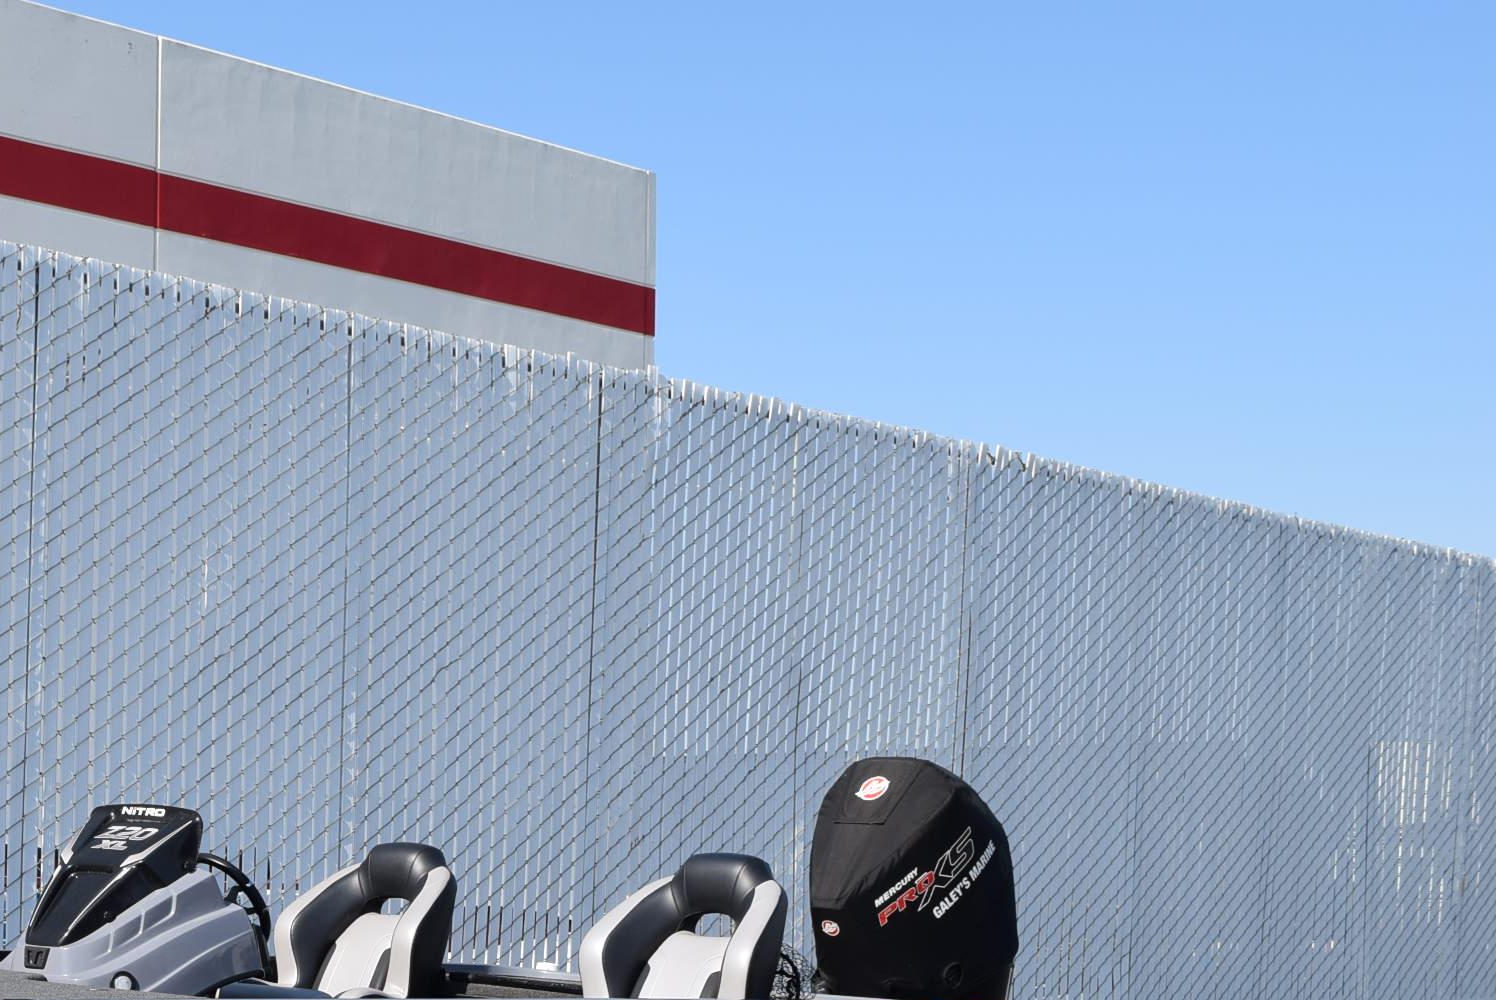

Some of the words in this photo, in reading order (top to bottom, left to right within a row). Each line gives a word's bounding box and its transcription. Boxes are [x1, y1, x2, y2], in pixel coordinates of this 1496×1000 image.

[121, 806, 166, 817] NITRO
[93, 825, 159, 841] Z20
[874, 866, 918, 908] MERCURY
[877, 870, 935, 927] PRO
[932, 877, 971, 919] GALEY'S
[968, 839, 996, 882] MARINE
